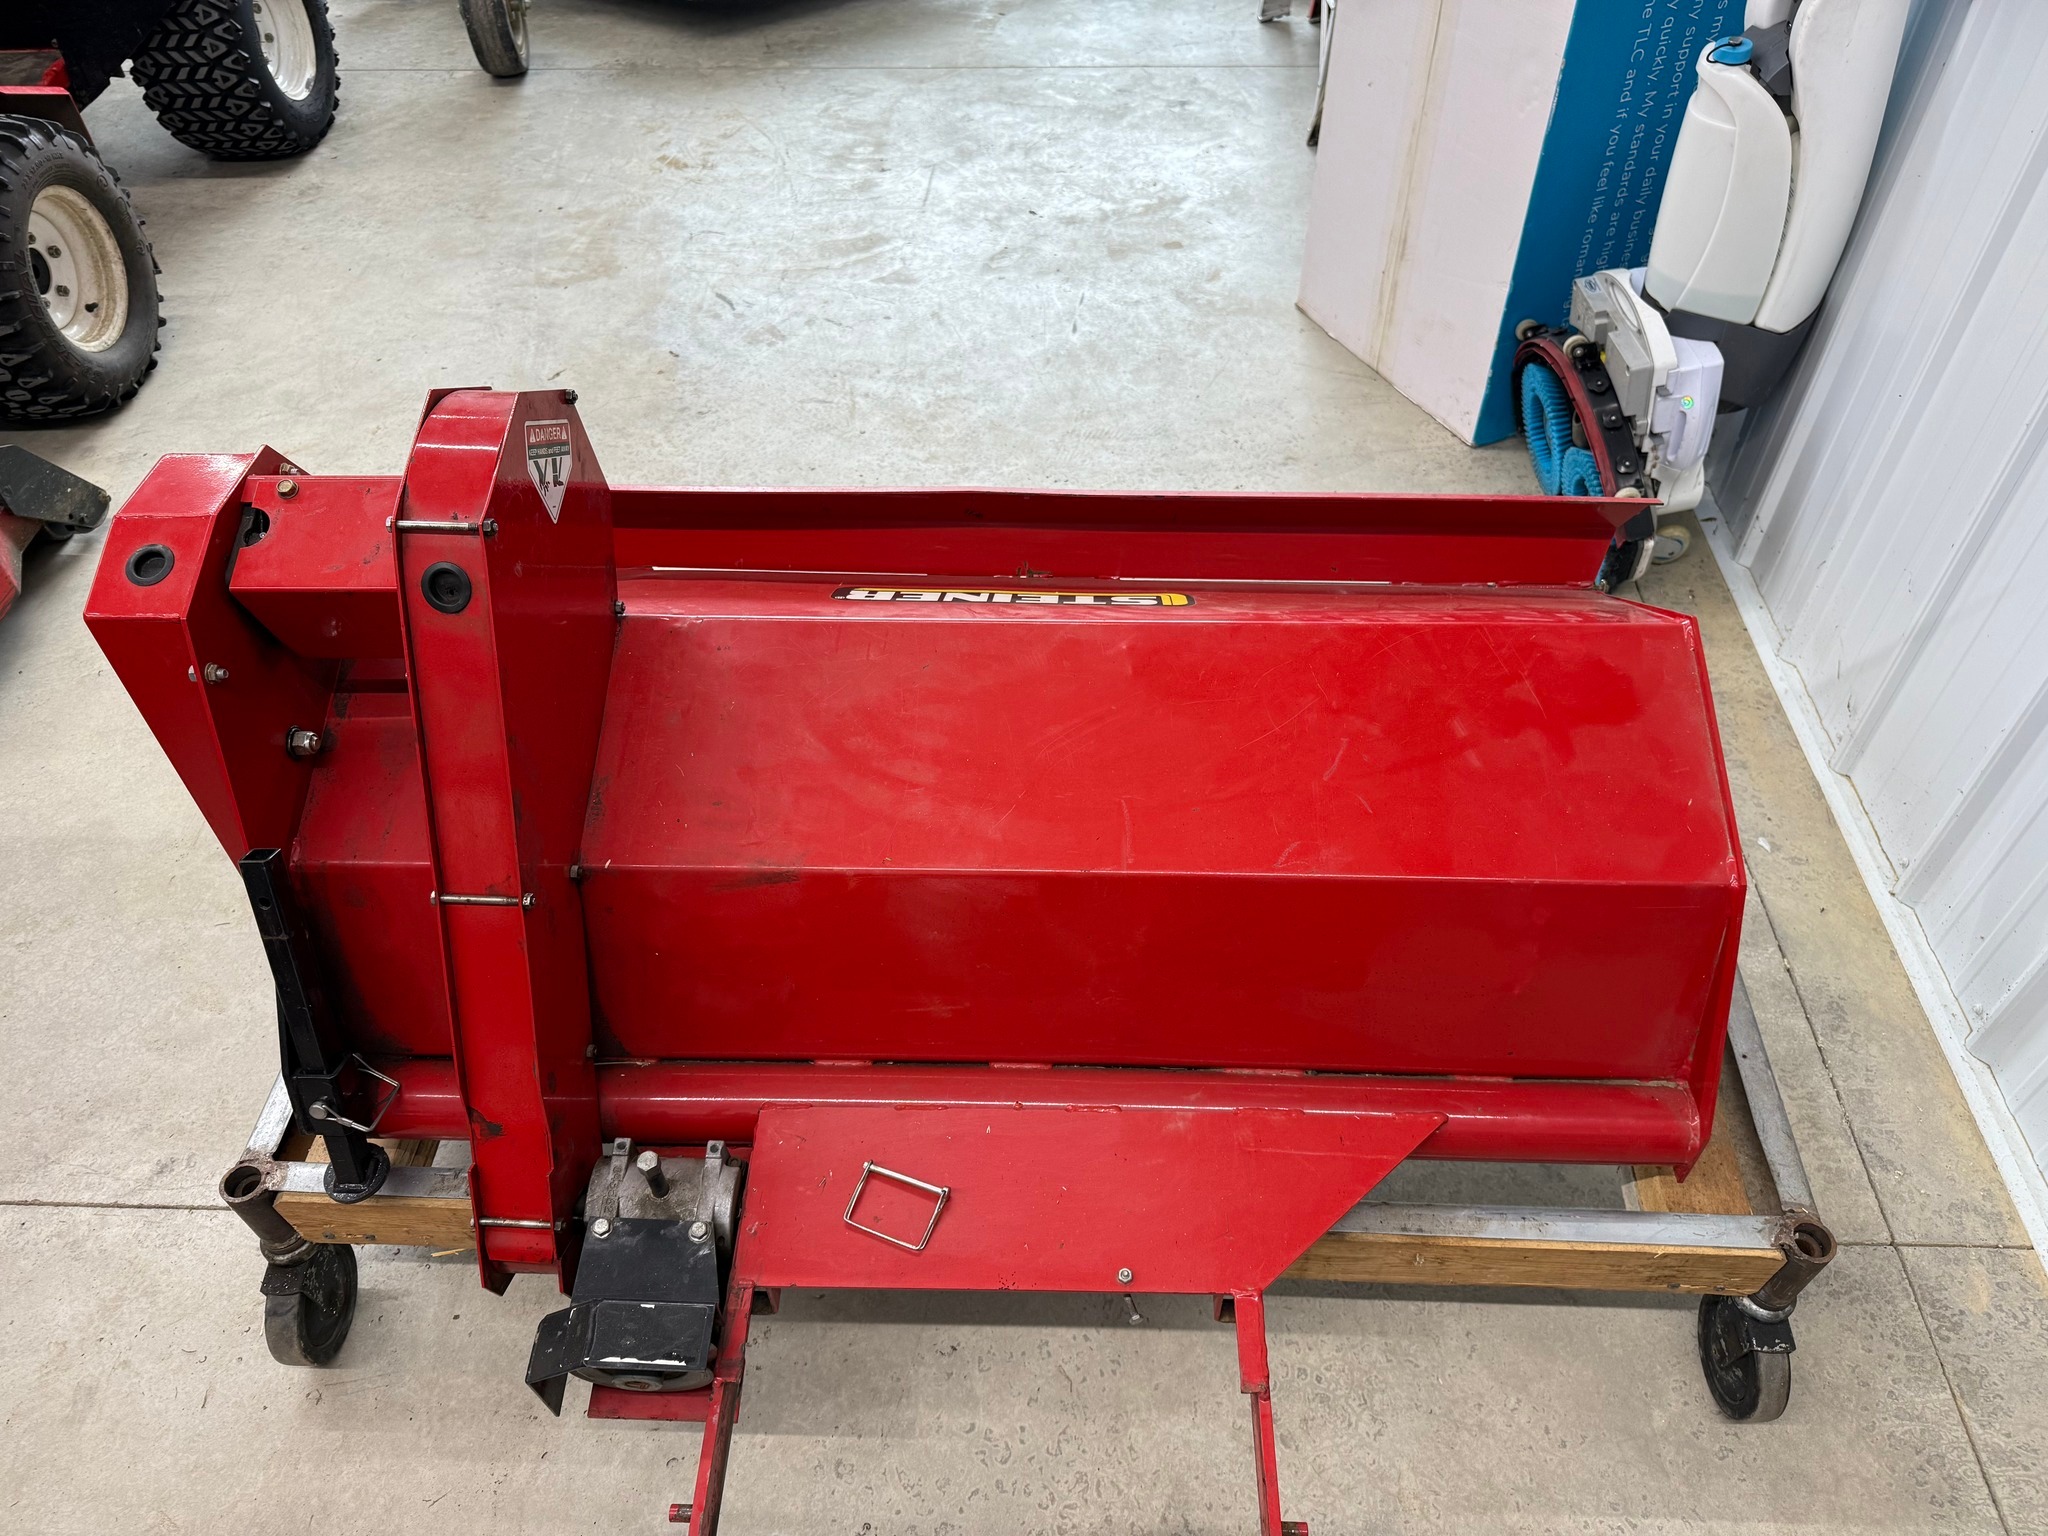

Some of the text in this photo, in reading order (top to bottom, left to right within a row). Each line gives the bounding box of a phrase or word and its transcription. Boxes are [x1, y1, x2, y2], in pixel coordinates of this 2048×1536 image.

[1631, 23, 1652, 62] TLC
[1705, 16, 1724, 43] my
[1647, 17, 1674, 86] quickly.
[1667, 26, 1696, 99] support
[1620, 69, 1636, 102] and
[1616, 107, 1629, 119] if
[1637, 91, 1657, 117] My
[1662, 103, 1677, 119] in
[1606, 124, 1622, 156] you
[1650, 124, 1668, 160] your
[1596, 161, 1614, 192] feel
[1614, 123, 1645, 207] standards
[1635, 167, 1657, 204] daily
[1588, 196, 1606, 224] like
[1606, 212, 1620, 236] are
[535, 427, 561, 441] DANGER
[846, 590, 1158, 606] STEINER
